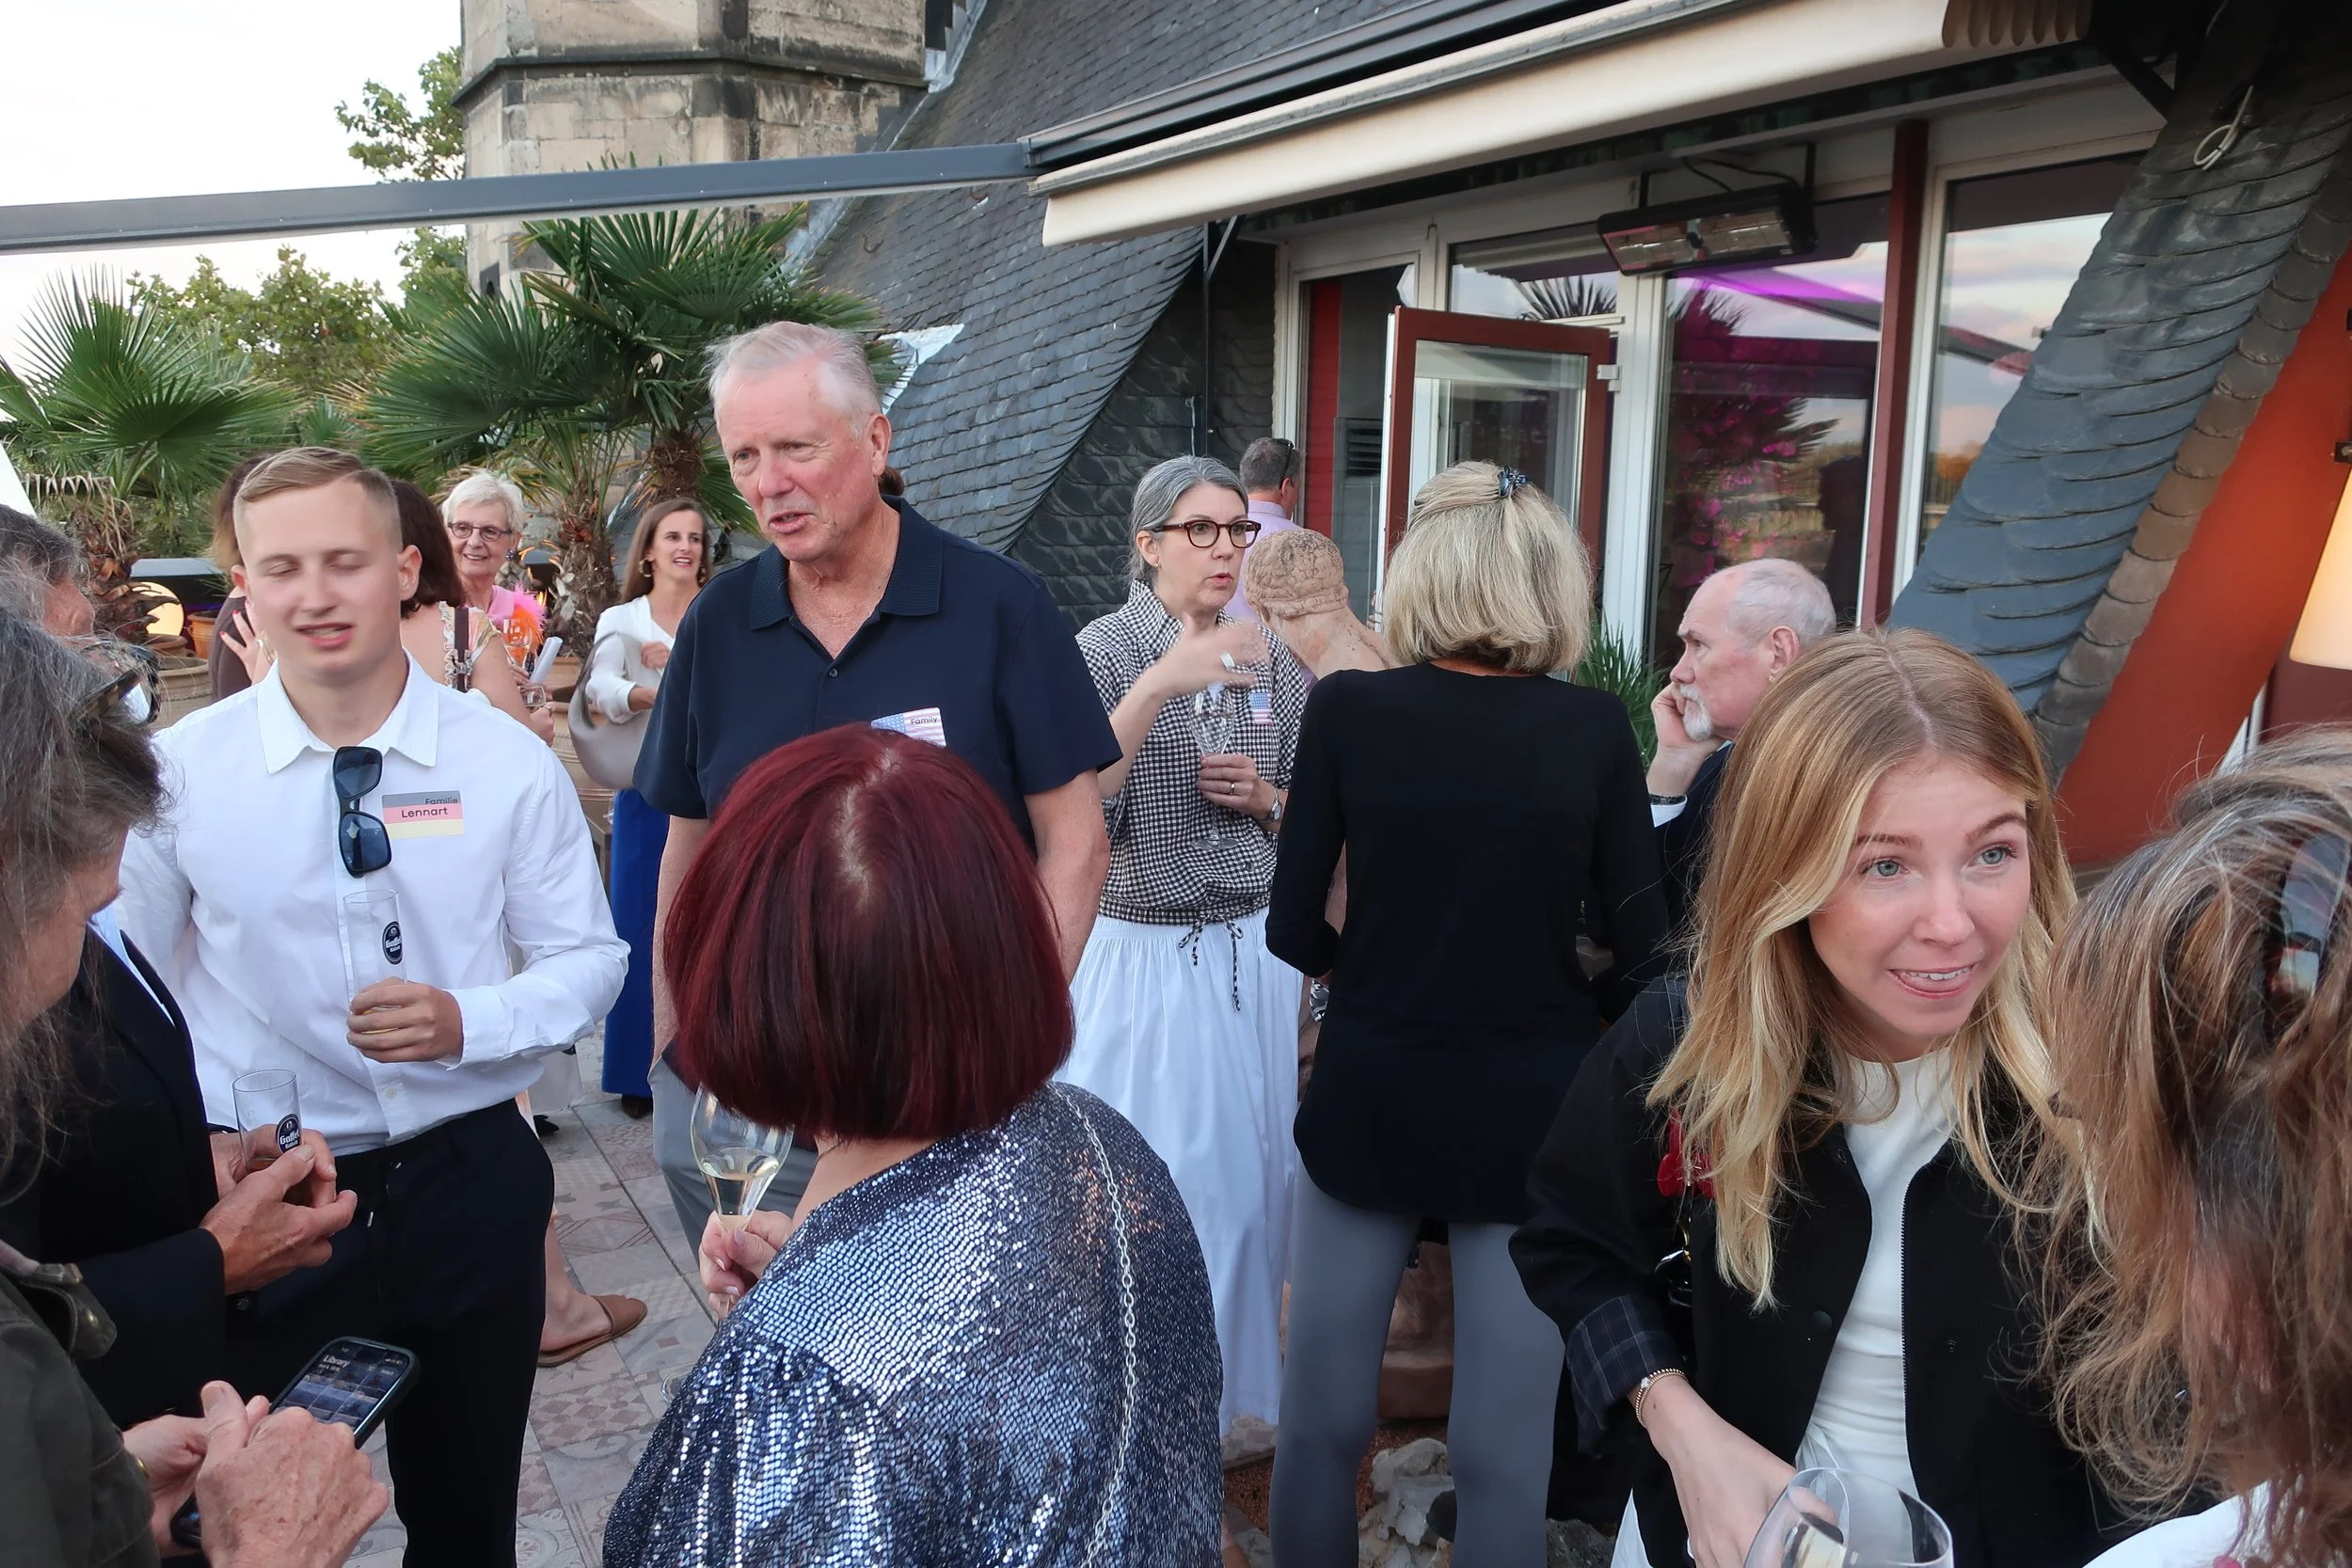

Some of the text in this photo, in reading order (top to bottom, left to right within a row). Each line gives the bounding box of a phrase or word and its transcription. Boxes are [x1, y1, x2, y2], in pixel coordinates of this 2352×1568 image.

[910, 716, 938, 725] Family
[424, 796, 459, 805] Familie
[401, 806, 449, 818] Lennart
[323, 1354, 351, 1369] Library
